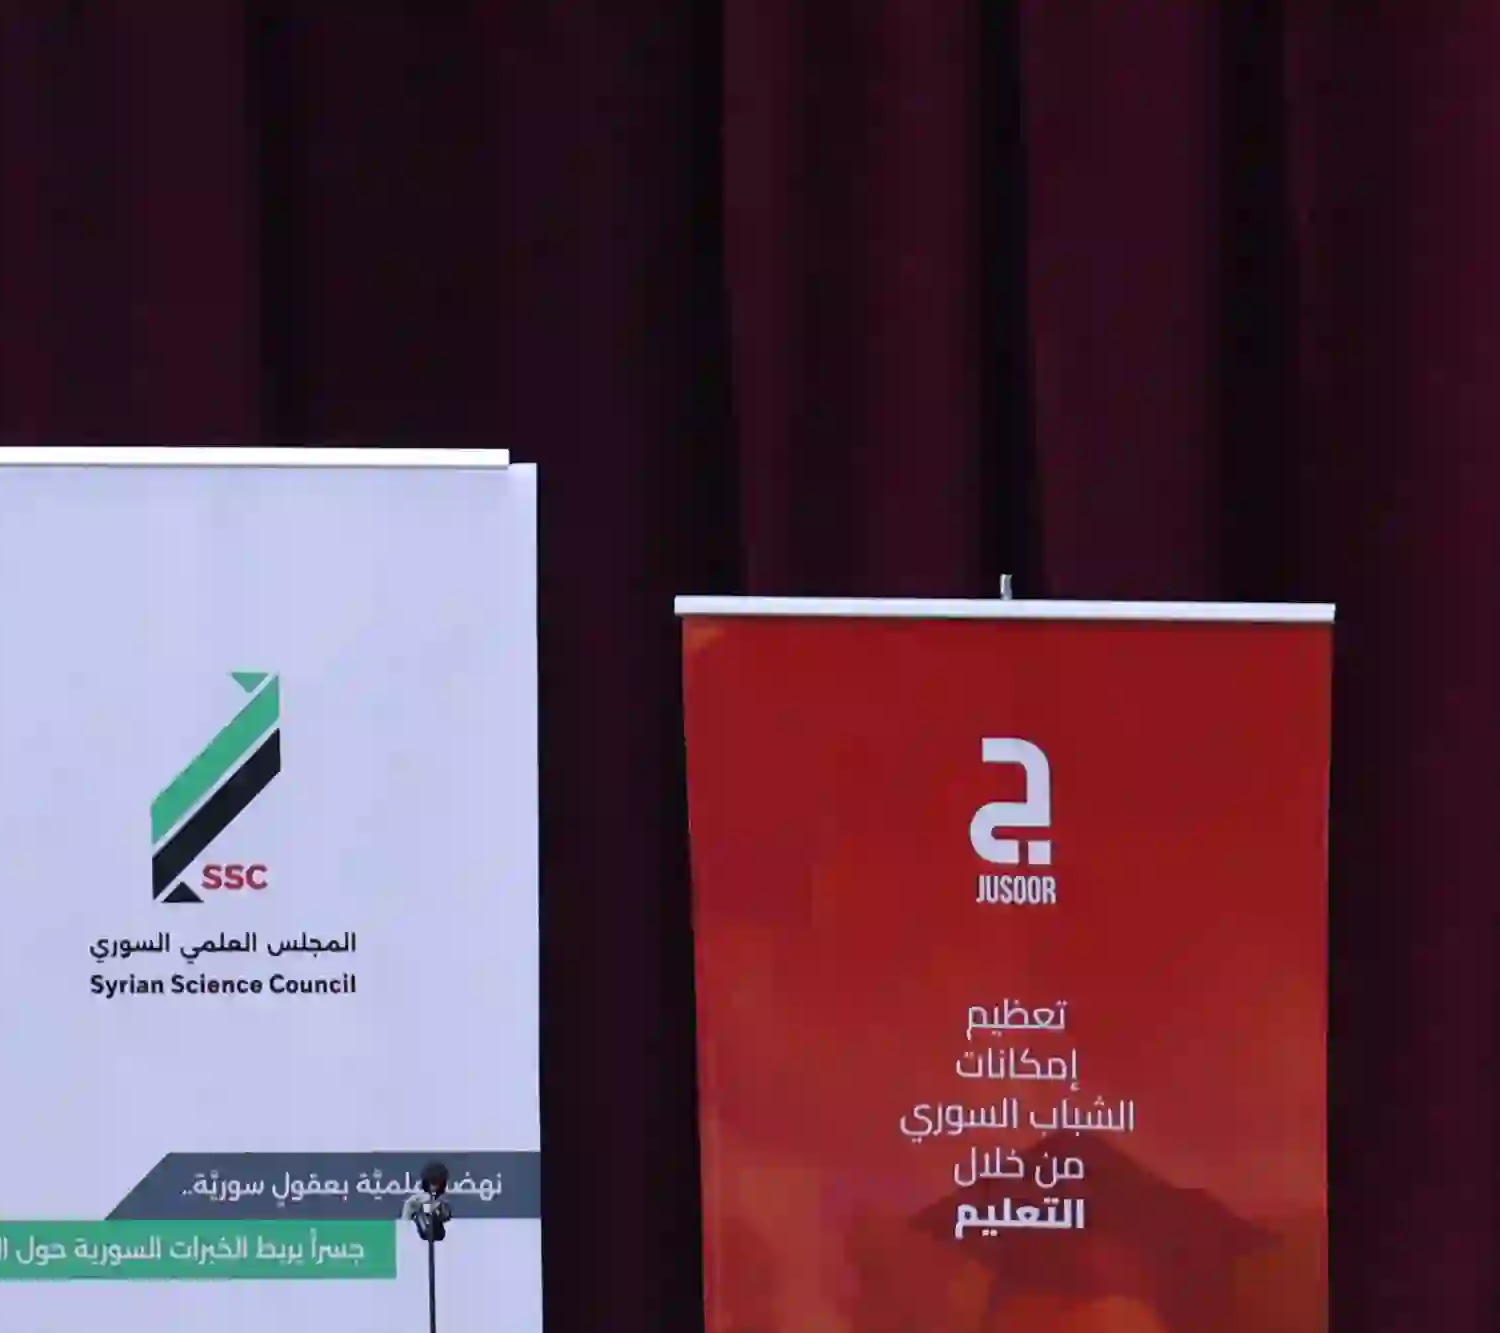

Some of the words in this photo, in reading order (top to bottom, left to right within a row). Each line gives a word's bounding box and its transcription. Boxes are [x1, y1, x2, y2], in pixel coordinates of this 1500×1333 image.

[201, 865, 269, 891] SSC
[976, 875, 1057, 905] JUSOOR
[89, 933, 170, 963] السوري
[180, 932, 257, 964] العلمي
[267, 932, 357, 958] المجلس
[90, 974, 164, 998] Syrian
[171, 974, 263, 996] Science
[269, 974, 357, 996] Council
[966, 999, 1067, 1041] تعظيم
[956, 1048, 1078, 1092] إمكانات
[899, 1098, 1018, 1142] السوري
[1029, 1096, 1135, 1137] الشباب
[954, 1147, 1025, 1186] خلال
[1034, 1152, 1085, 1189] من
[445, 1171, 503, 1201] نهض
[955, 1198, 1086, 1239] التعليم
[16, 1236, 68, 1266] حول
[74, 1236, 162, 1266] السورية
[170, 1236, 248, 1265] الخبرات
[256, 1236, 304, 1265] يربط
